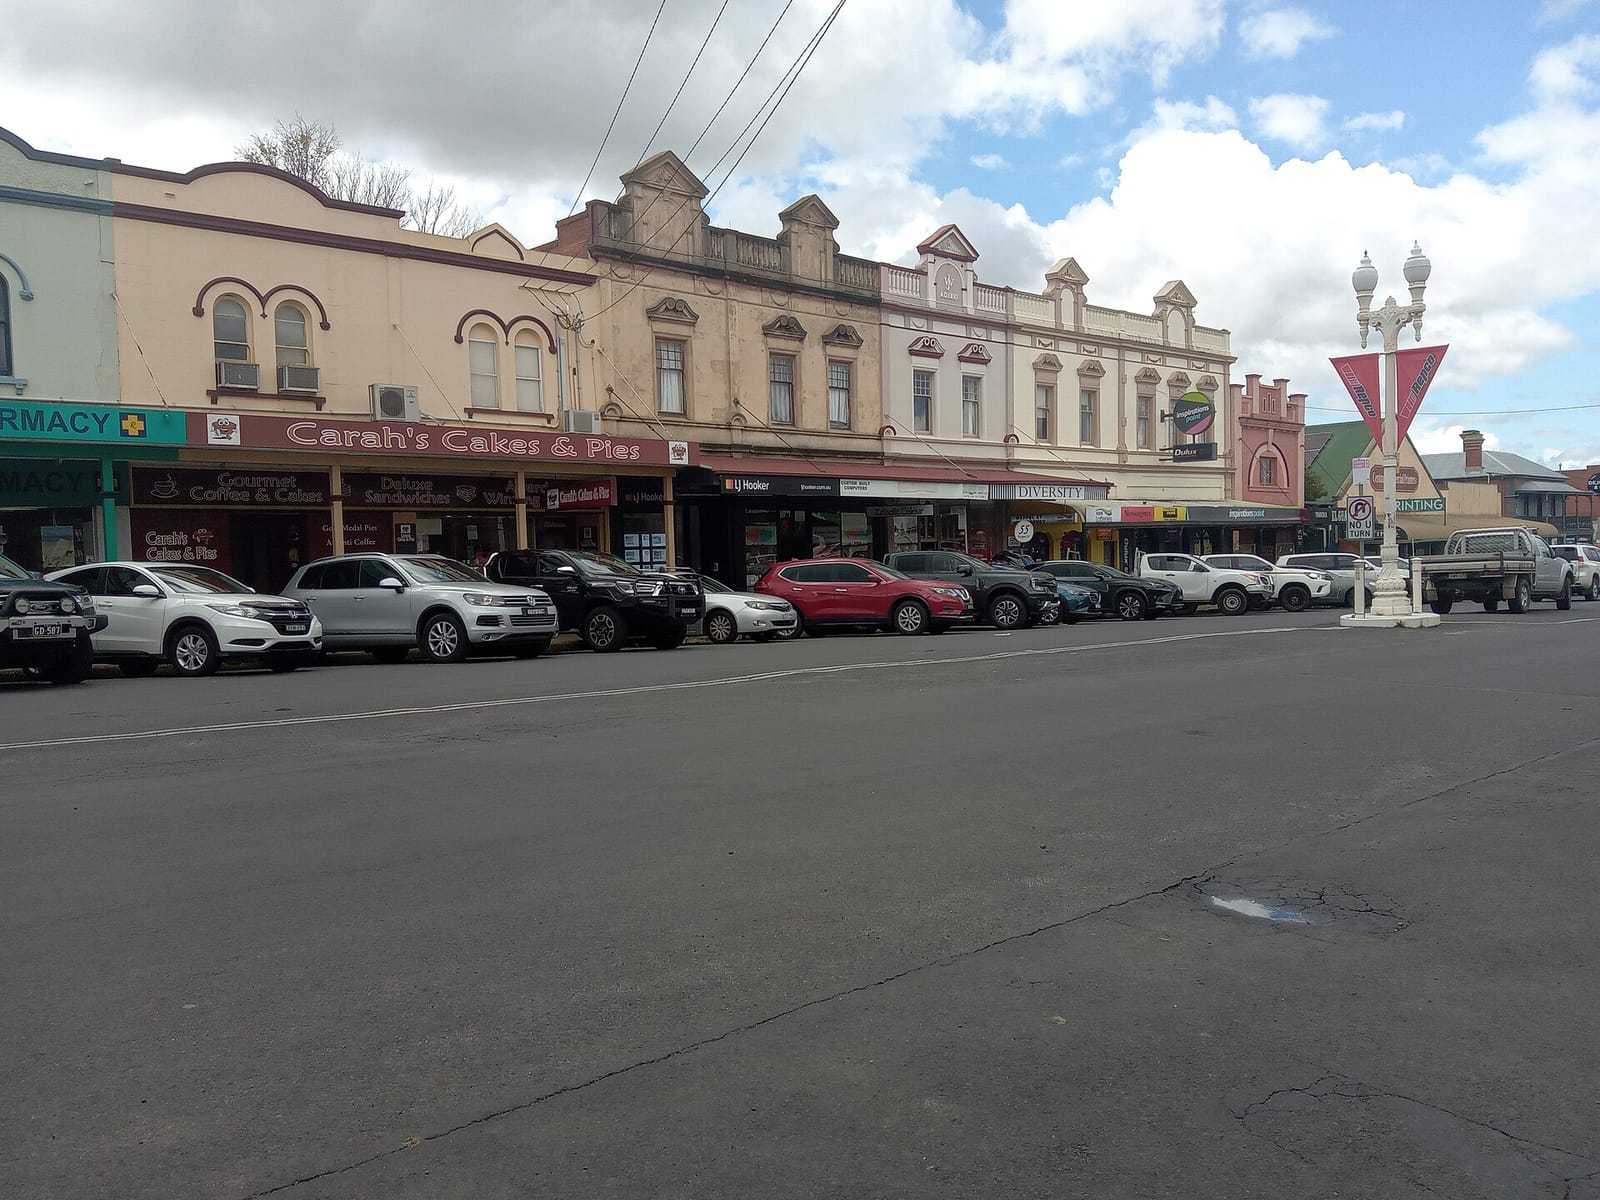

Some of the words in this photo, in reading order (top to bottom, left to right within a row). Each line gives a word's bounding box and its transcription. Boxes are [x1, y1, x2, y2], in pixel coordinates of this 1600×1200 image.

[1412, 354, 1436, 397] Repco
[1353, 384, 1377, 417] Repco
[1176, 405, 1210, 418] inspirations
[0, 408, 110, 434] RMACY
[286, 421, 430, 450] Carah's
[441, 430, 541, 455] Cakes
[551, 437, 577, 457] &
[586, 438, 640, 460] Pies
[1174, 448, 1198, 457] Dulux
[217, 472, 297, 488] Gourmet
[381, 476, 434, 491] Deluxe
[505, 480, 549, 494] Aard
[743, 480, 770, 491] Hooker
[190, 486, 250, 502] Coffee
[255, 488, 270, 501] &
[275, 488, 323, 502] Cakes
[365, 490, 451, 504] Sandwiches
[641, 492, 664, 502] Hooke
[1018, 485, 1083, 499] DIVERSITY
[482, 491, 541, 509] Winng
[1395, 499, 1444, 511] RINTING
[1018, 524, 1030, 535] 55
[1349, 521, 1362, 529] NO
[1365, 521, 1372, 529] U
[145, 530, 188, 546] Carah's
[146, 547, 181, 561] Cakes
[183, 548, 195, 561] &
[195, 546, 217, 561] Pies
